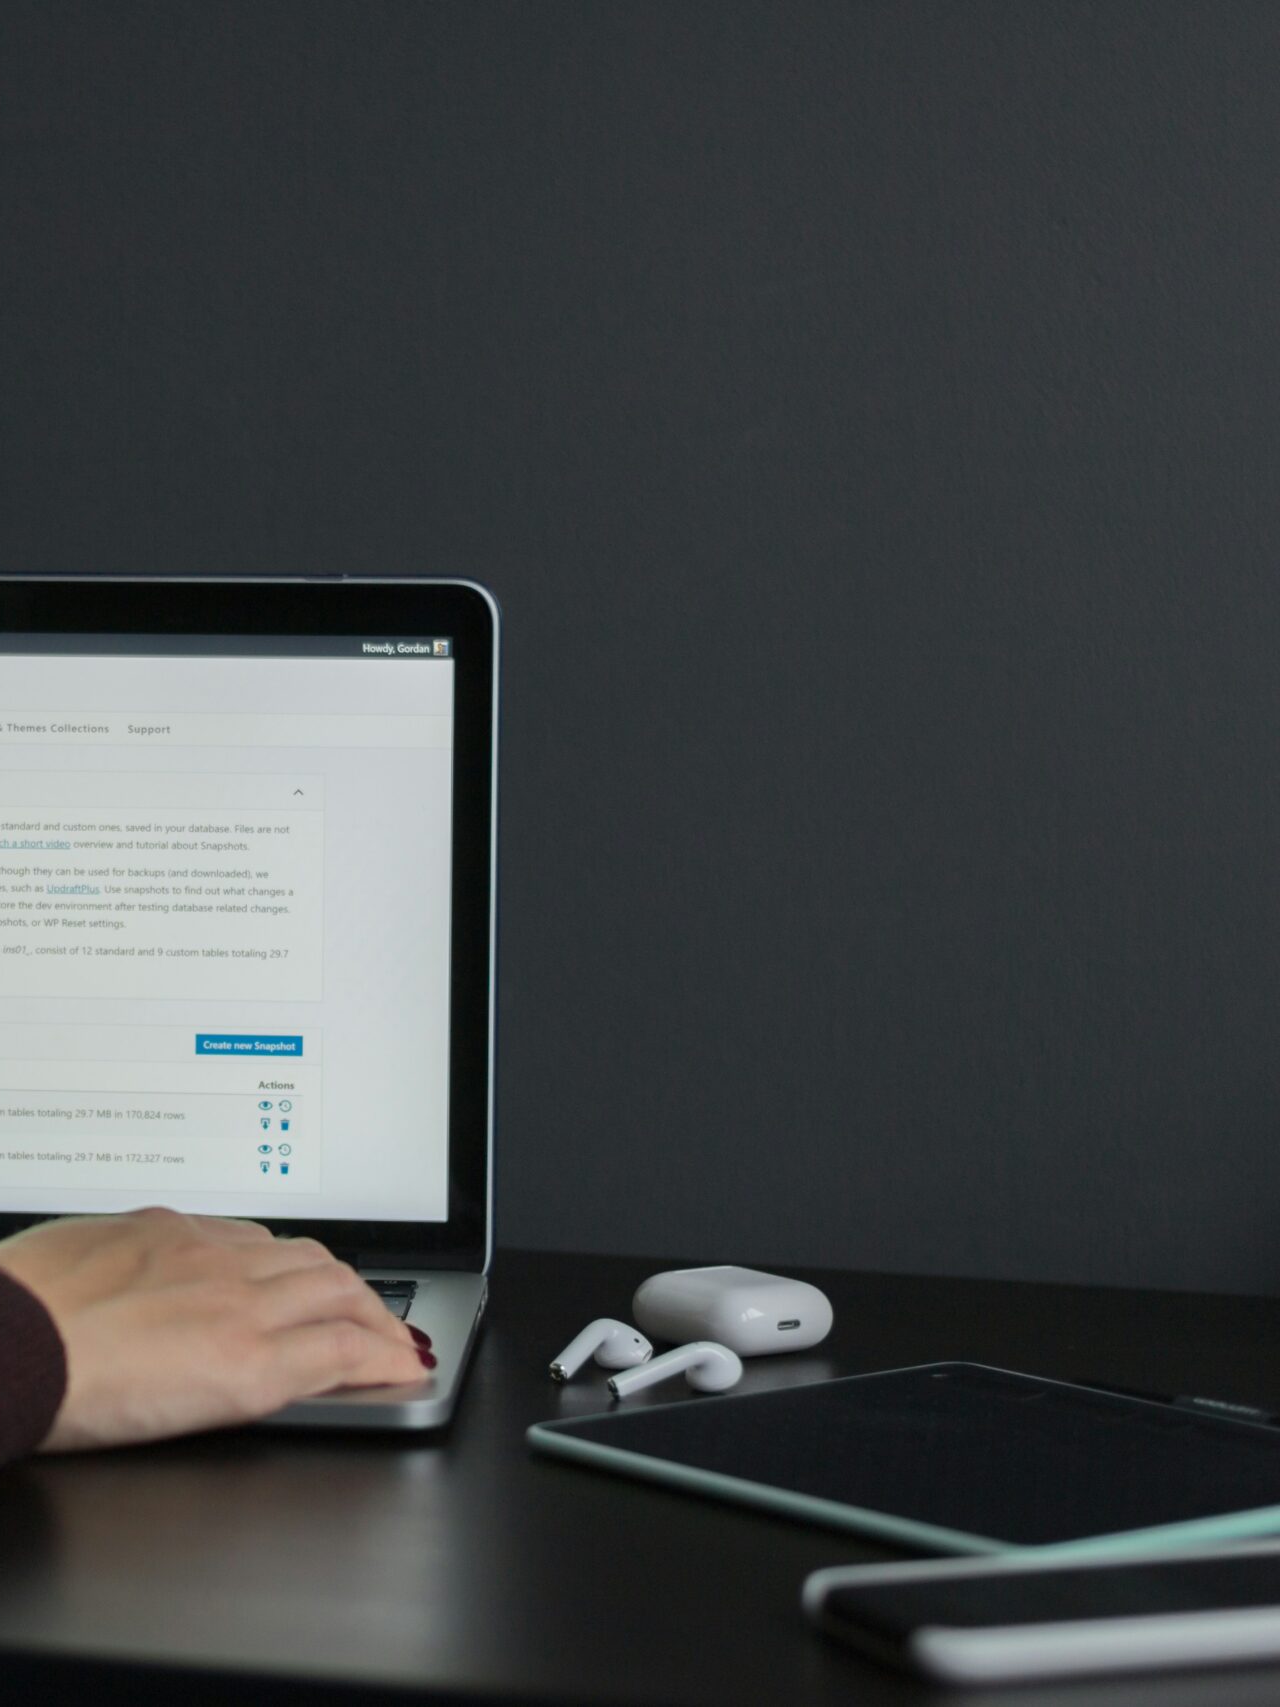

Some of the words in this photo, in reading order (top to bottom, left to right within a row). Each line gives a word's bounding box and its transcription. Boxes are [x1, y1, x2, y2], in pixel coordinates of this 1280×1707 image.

[362, 643, 395, 655] Howdy,
[397, 643, 429, 654] Gordan
[7, 723, 47, 733] Themes
[50, 723, 109, 734] Collections
[128, 724, 170, 736] Support
[12, 841, 18, 849] a
[20, 839, 44, 849] short
[46, 839, 70, 849] video
[73, 840, 114, 849] overview
[116, 840, 133, 849] and
[136, 840, 169, 850] tutorial
[171, 840, 198, 850] about
[201, 841, 249, 853] Snapshots.
[33, 867, 53, 878] they
[55, 868, 71, 876] can
[74, 867, 86, 876] be
[88, 867, 110, 877] used
[112, 867, 125, 877] for
[128, 868, 165, 879] backups
[168, 869, 188, 878] (and
[255, 871, 269, 879] we
[43, 918, 60, 927] WP
[61, 918, 86, 928] Reset
[89, 920, 126, 930] settings.
[35, 946, 67, 955] consist
[69, 946, 79, 955] of
[82, 946, 92, 956] 12
[95, 947, 135, 956] standard
[138, 947, 155, 957] and
[157, 947, 163, 957] 9
[165, 949, 199, 957] custom
[202, 948, 229, 958] tables
[231, 949, 267, 960] totaling
[269, 949, 288, 959] 29.7
[203, 1040, 232, 1050] Create
[254, 1041, 296, 1053] Snapshot
[258, 1081, 295, 1090] Actions
[7, 1108, 35, 1117] tables
[37, 1108, 72, 1120] totaling
[75, 1109, 94, 1119] 29.7
[96, 1109, 112, 1119] MB
[114, 1111, 123, 1119] in
[163, 1112, 186, 1121] rows
[7, 1151, 35, 1161] tables
[37, 1152, 72, 1164] totaling
[74, 1152, 94, 1162] 29.7
[96, 1153, 111, 1162] MB
[114, 1154, 123, 1162] in
[163, 1156, 185, 1164] rows
